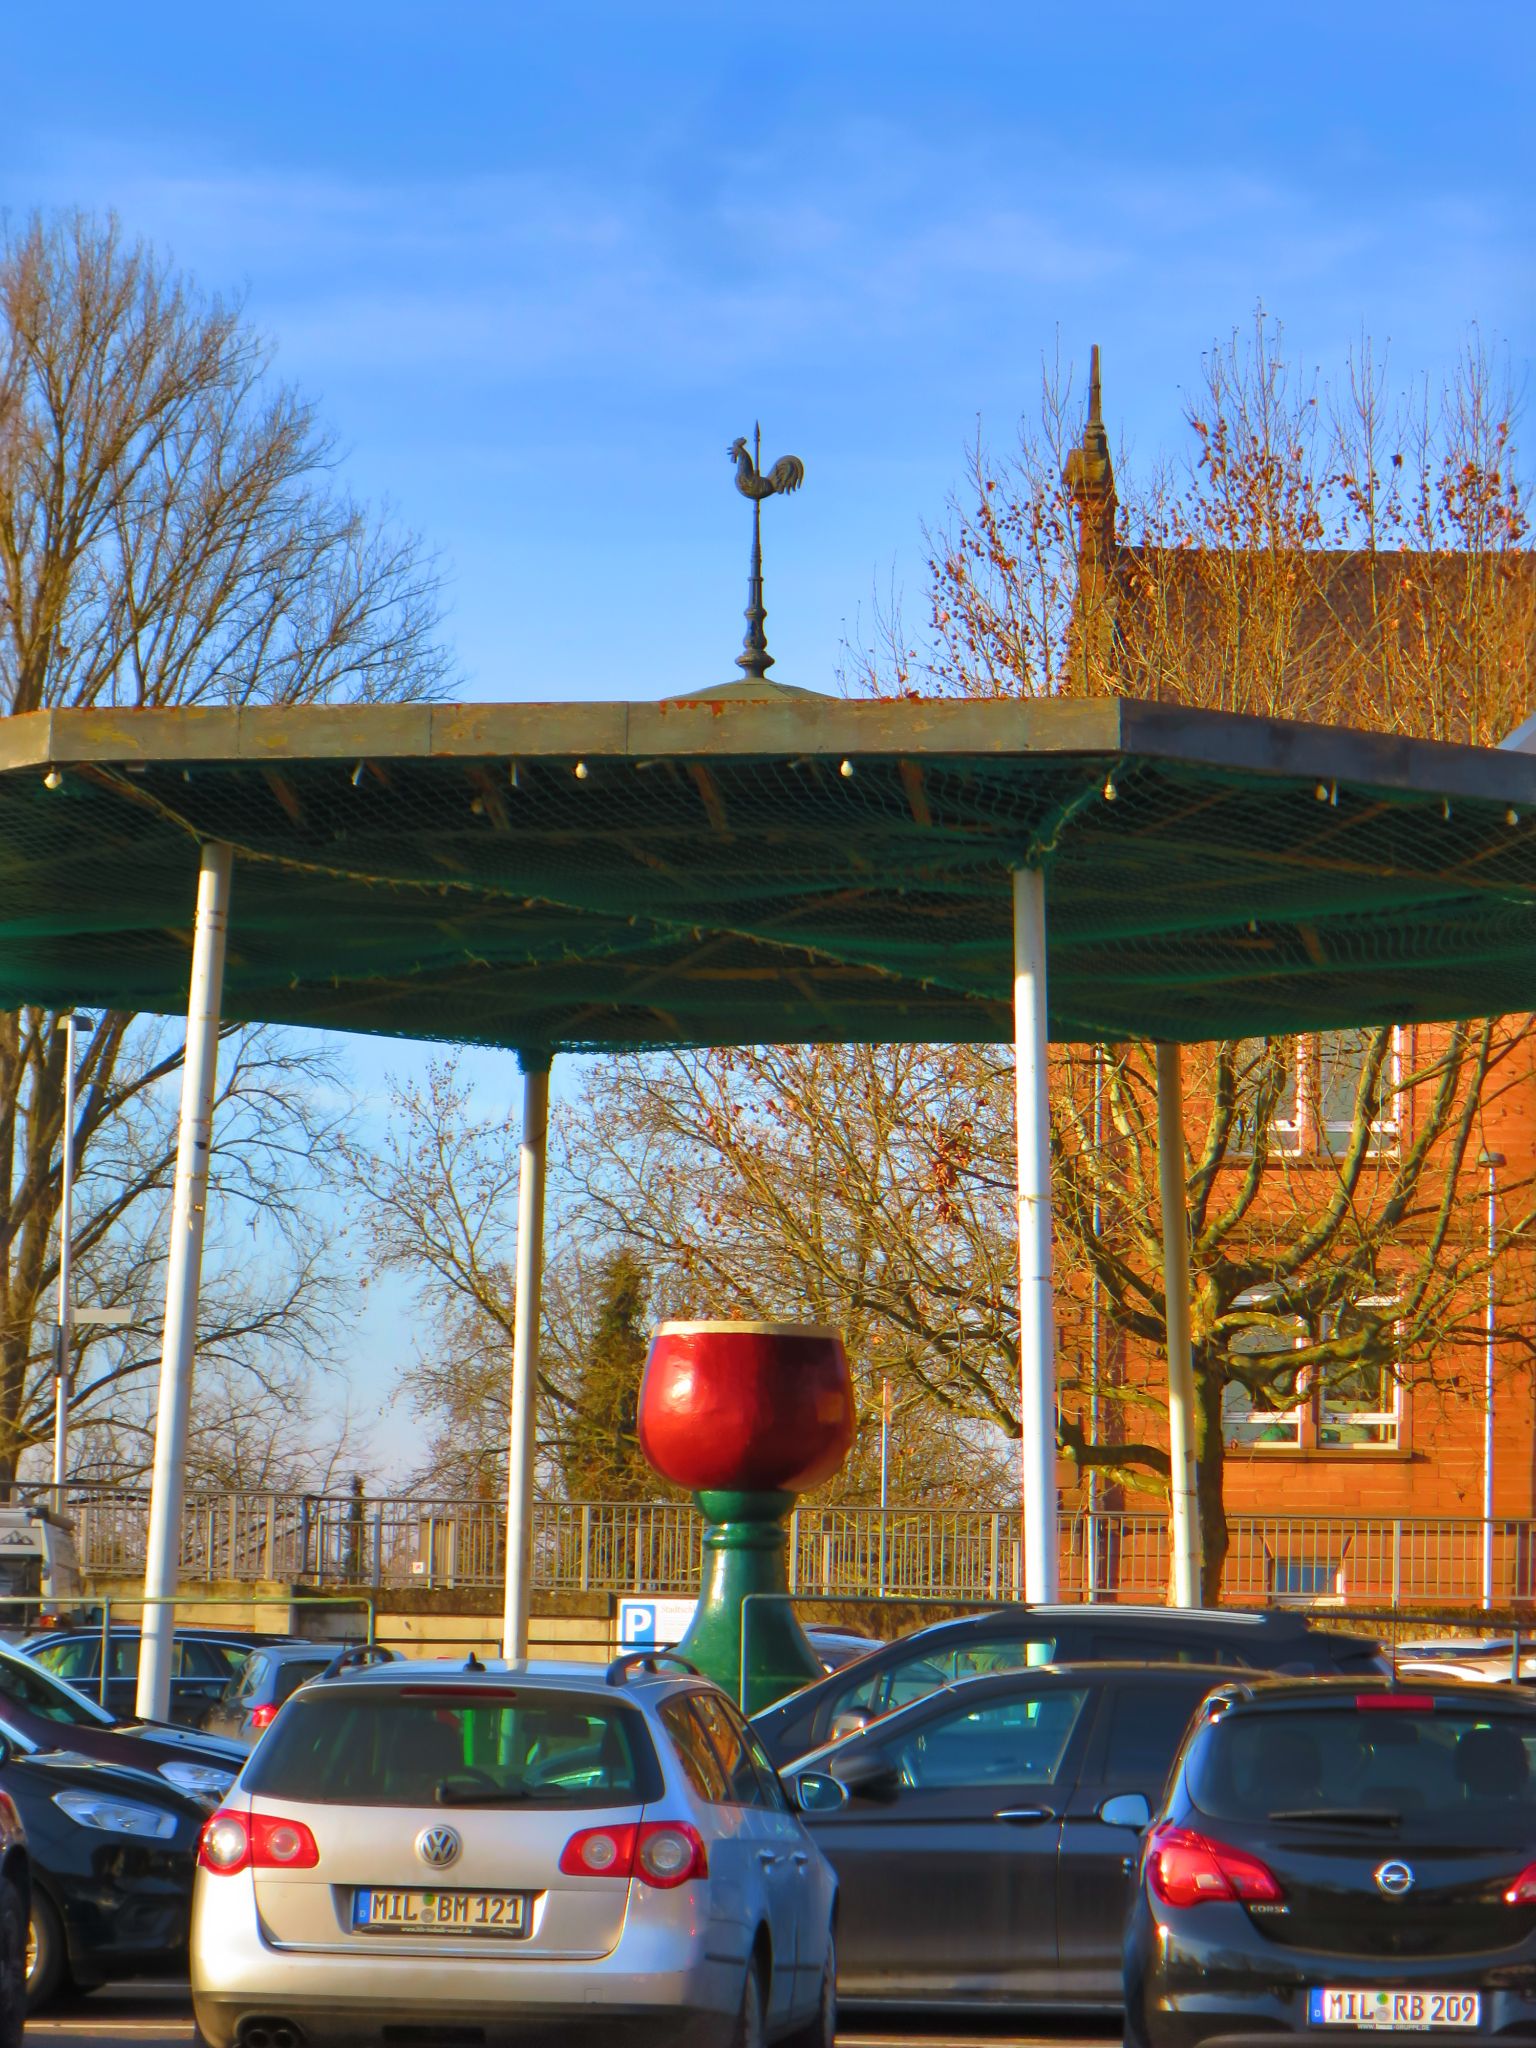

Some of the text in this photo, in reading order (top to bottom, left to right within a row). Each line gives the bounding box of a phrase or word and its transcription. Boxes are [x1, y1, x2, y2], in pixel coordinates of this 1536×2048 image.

[625, 1608, 652, 1643] P
[373, 1894, 520, 1924] MIL BM 121
[1250, 1904, 1290, 1915] CORSA
[1328, 1994, 1475, 2021] MIL RB 209
